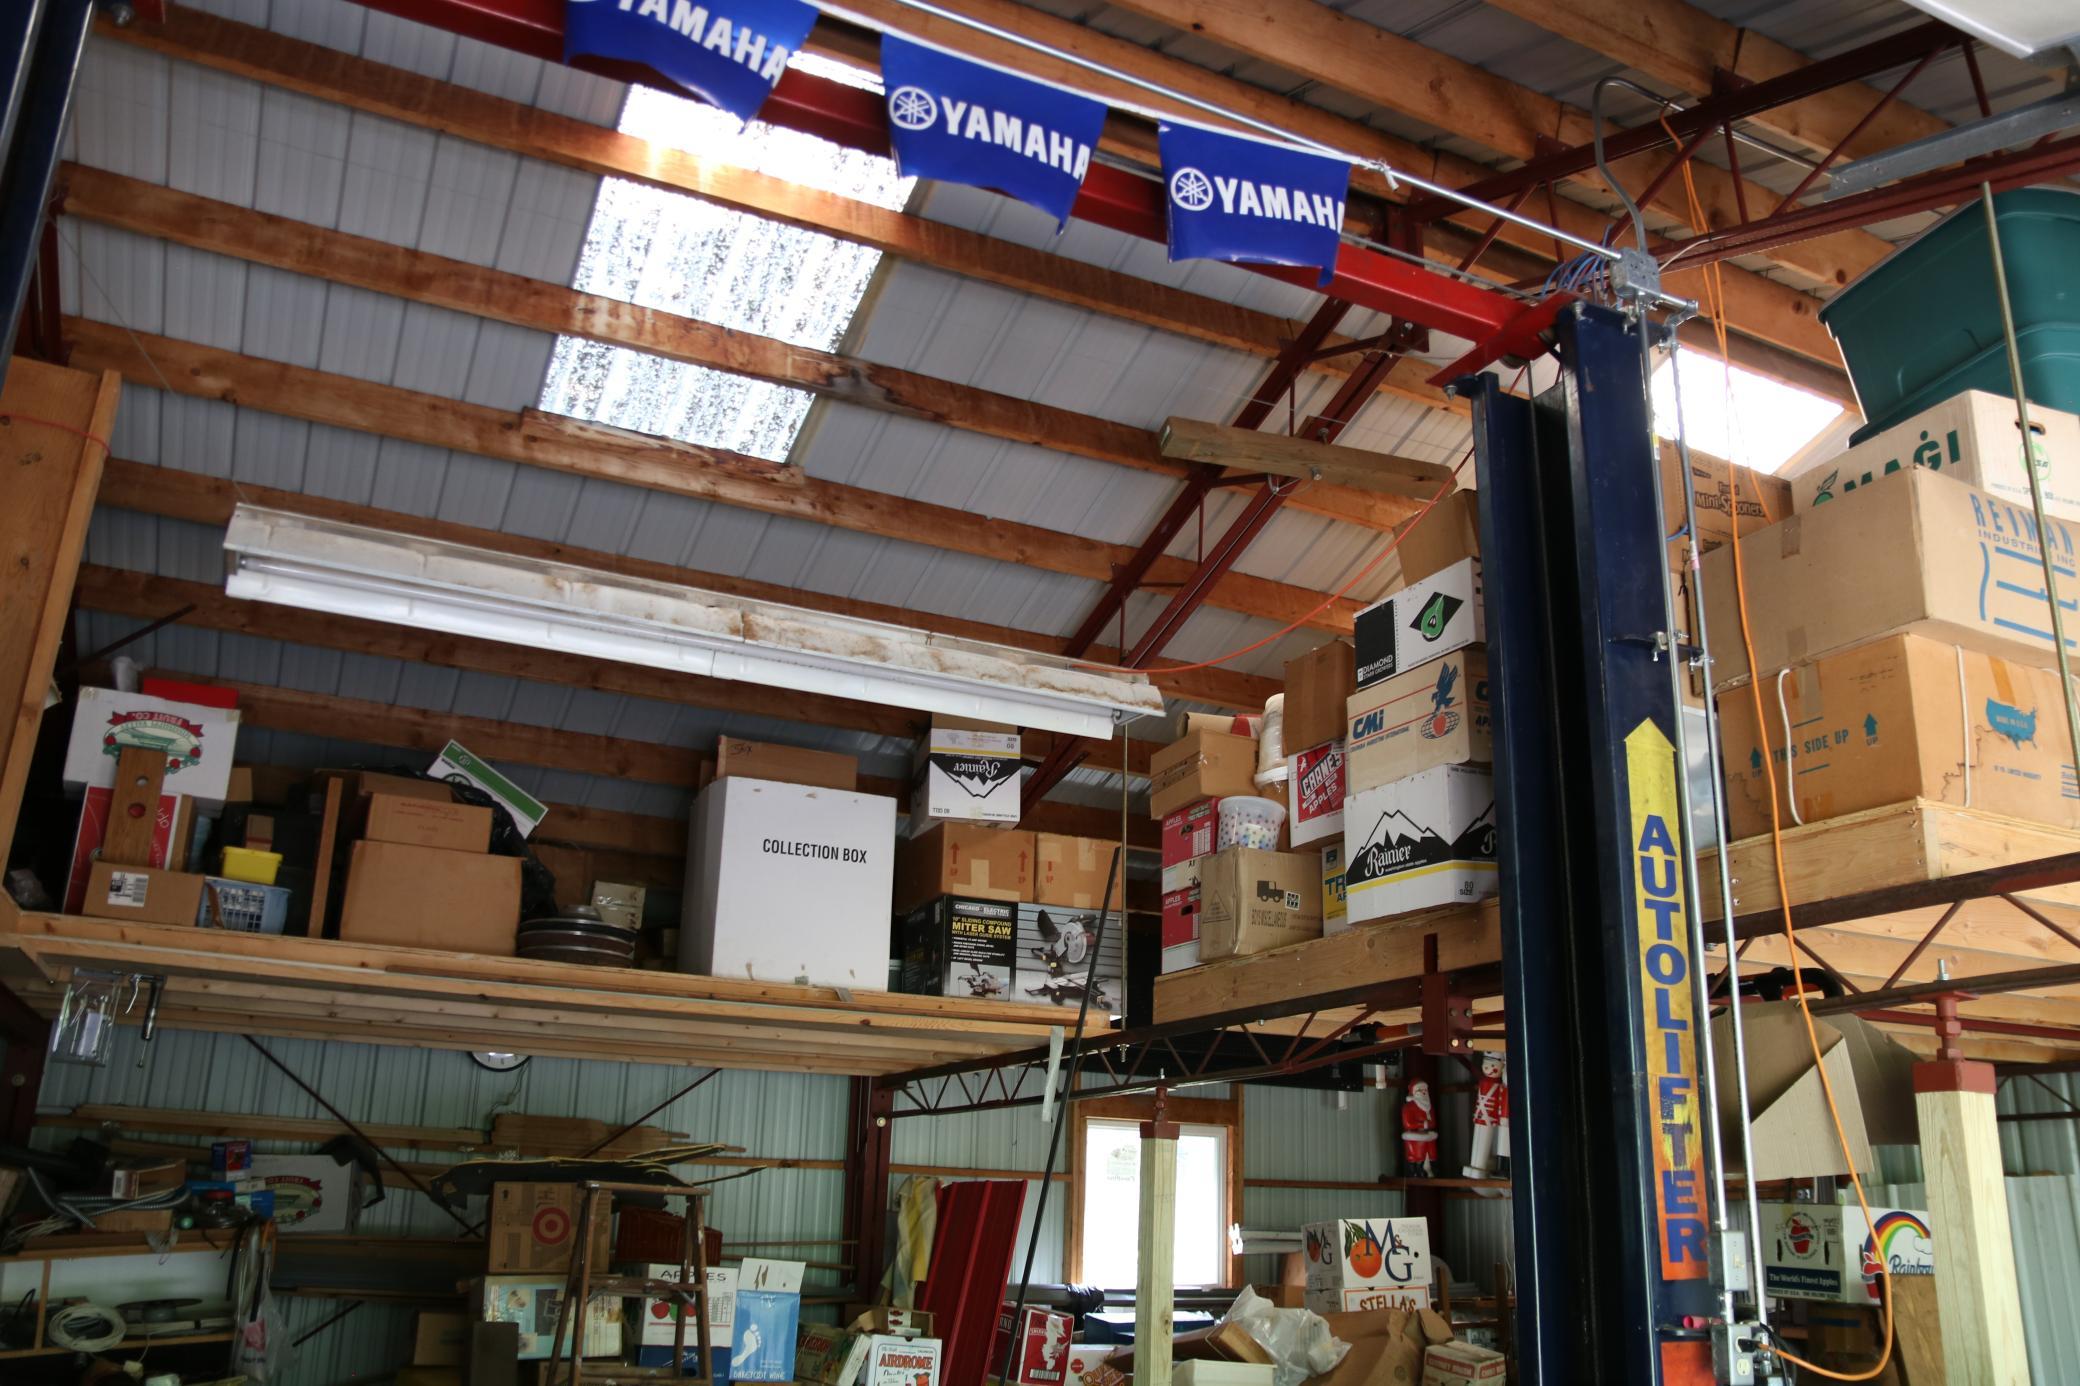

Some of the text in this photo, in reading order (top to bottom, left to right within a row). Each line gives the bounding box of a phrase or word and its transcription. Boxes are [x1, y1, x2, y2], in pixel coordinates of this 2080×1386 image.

[1363, 655, 1393, 673] DIAMOND
[1773, 729, 1849, 763] THS SIDE UP
[1866, 735, 1879, 746] UP
[953, 759, 1000, 778] Rainier
[1309, 783, 1337, 814] APPLES
[763, 838, 867, 864] COLLECTION BOX
[1365, 844, 1412, 877] Rainier
[952, 921, 1012, 935] MITER SAW
[1638, 814, 1708, 1263] AUTOLIFTER
[661, 1270, 727, 1282] APES
[879, 1353, 934, 1371] AIRDROME
